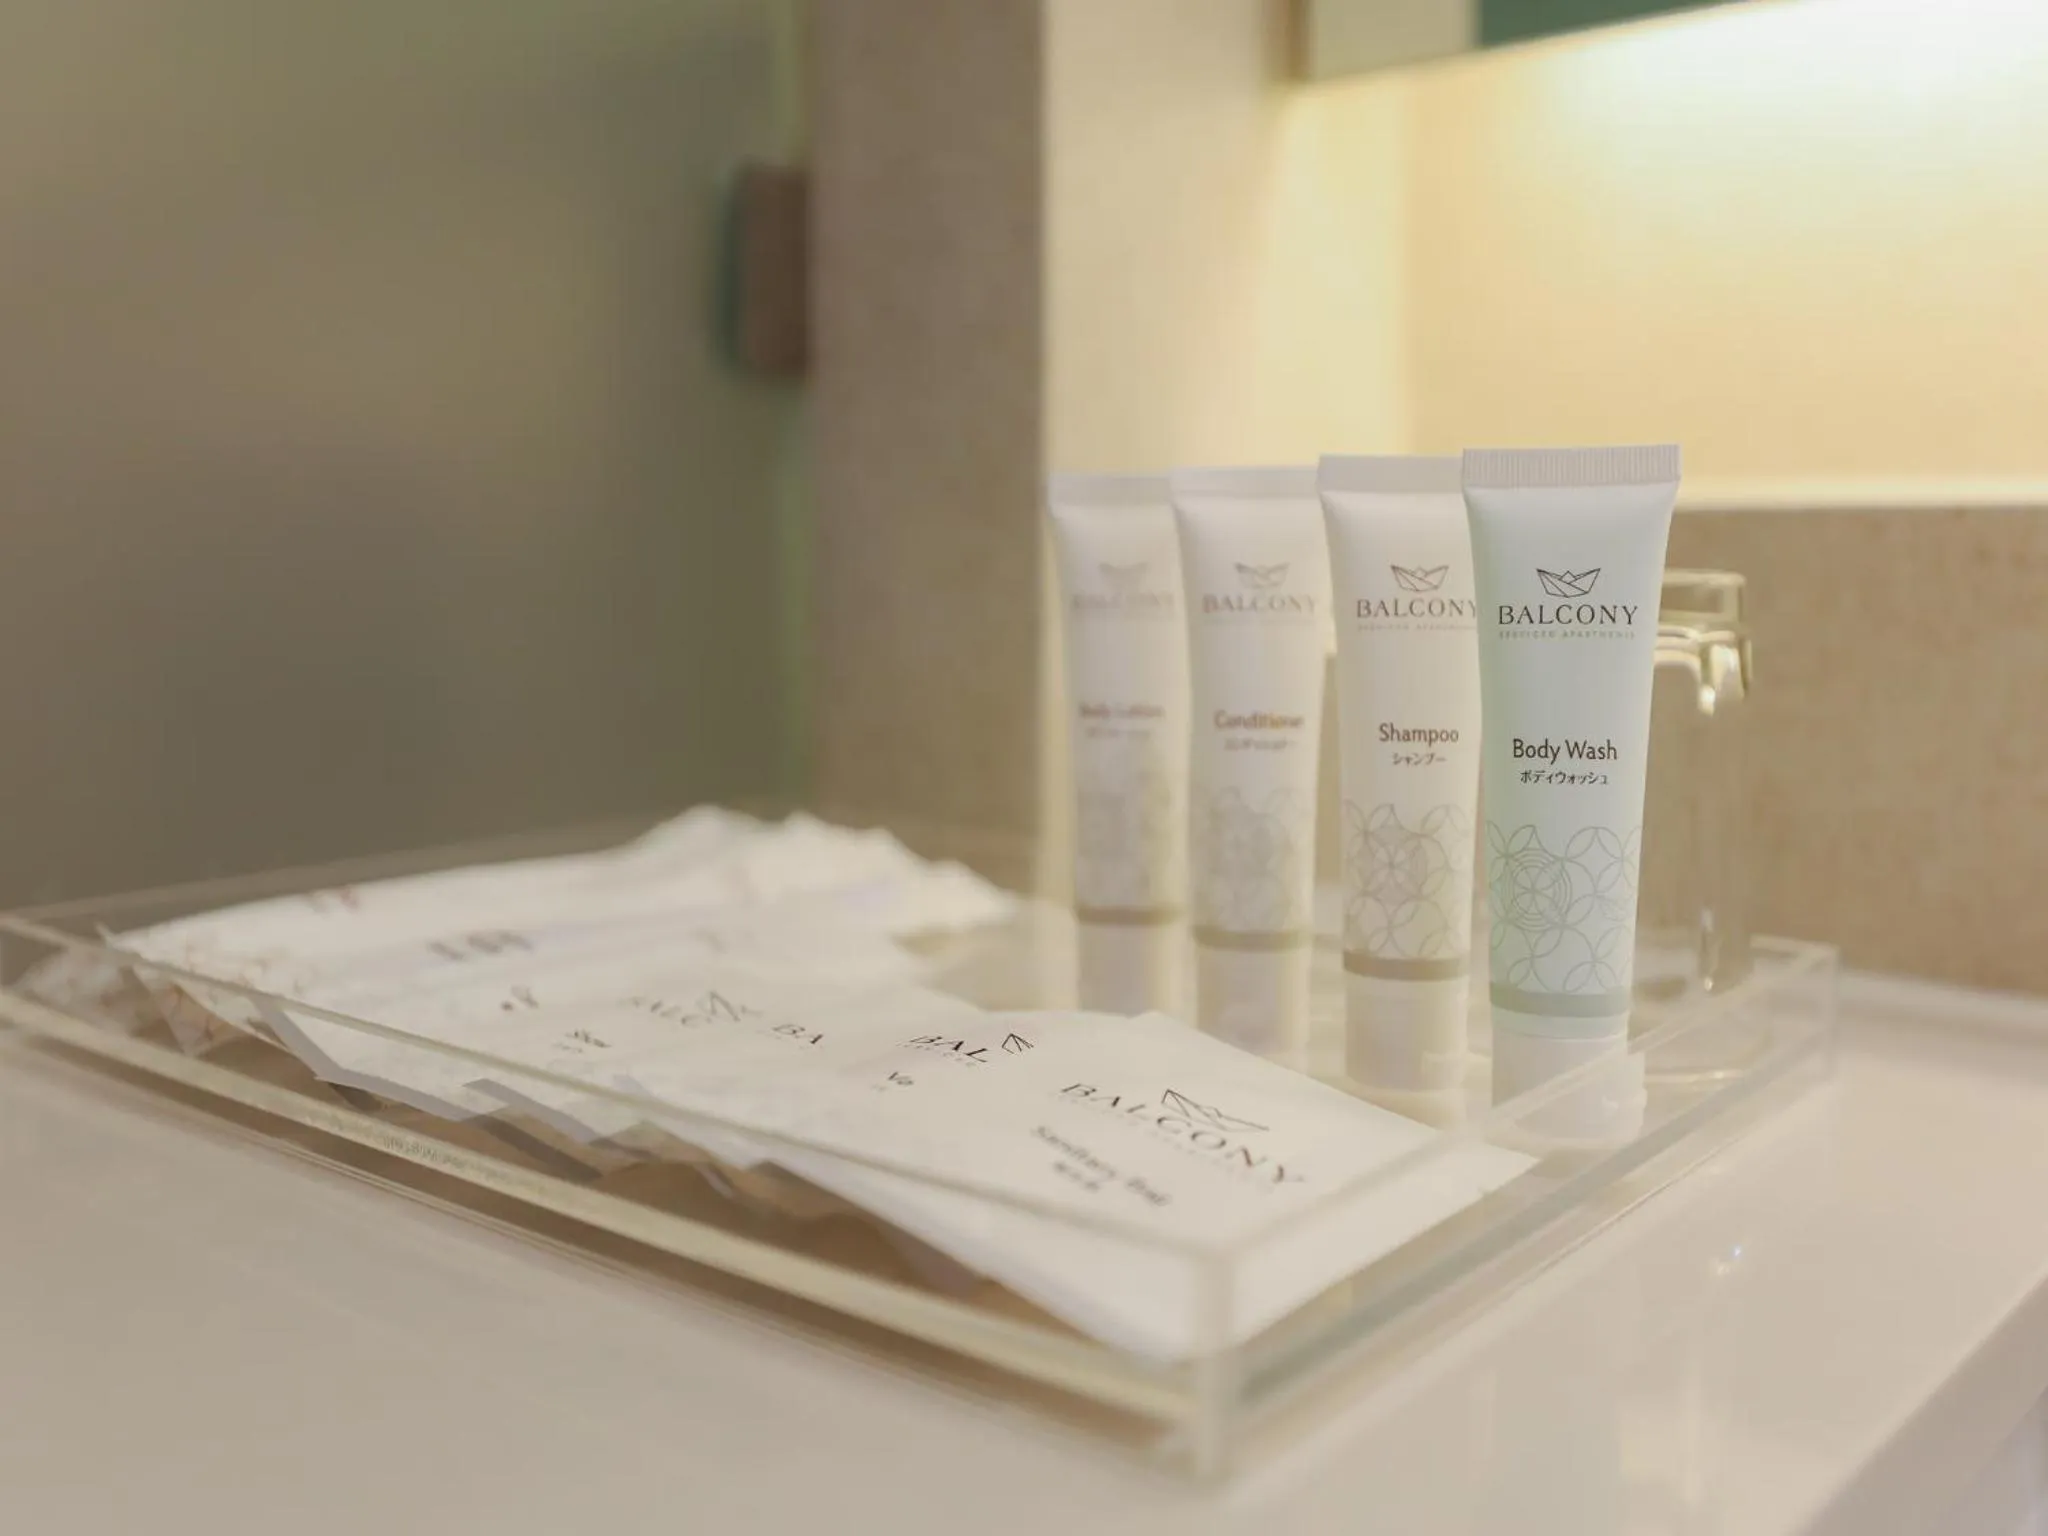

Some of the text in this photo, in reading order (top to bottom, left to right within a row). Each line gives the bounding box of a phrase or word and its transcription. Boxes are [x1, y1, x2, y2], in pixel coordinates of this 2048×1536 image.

[1356, 598, 1476, 619] BALCONY
[1498, 604, 1638, 626] BALCONY
[1379, 721, 1459, 748] Shampoo
[1512, 738, 1618, 766] Body Wash
